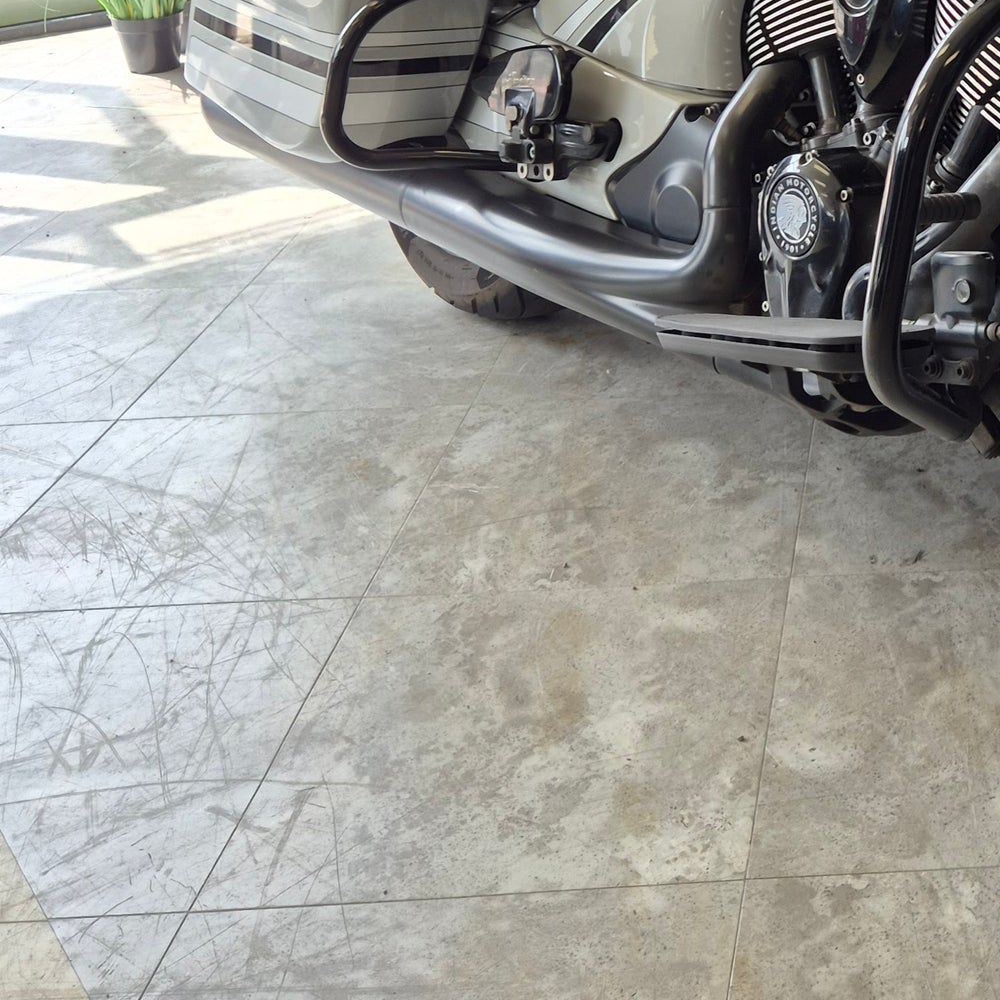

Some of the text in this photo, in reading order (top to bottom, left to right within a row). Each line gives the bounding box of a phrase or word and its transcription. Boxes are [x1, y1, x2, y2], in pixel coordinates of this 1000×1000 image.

[770, 178, 818, 246] INDIAN MOTORCYCLE
[780, 240, 799, 253] 1901
